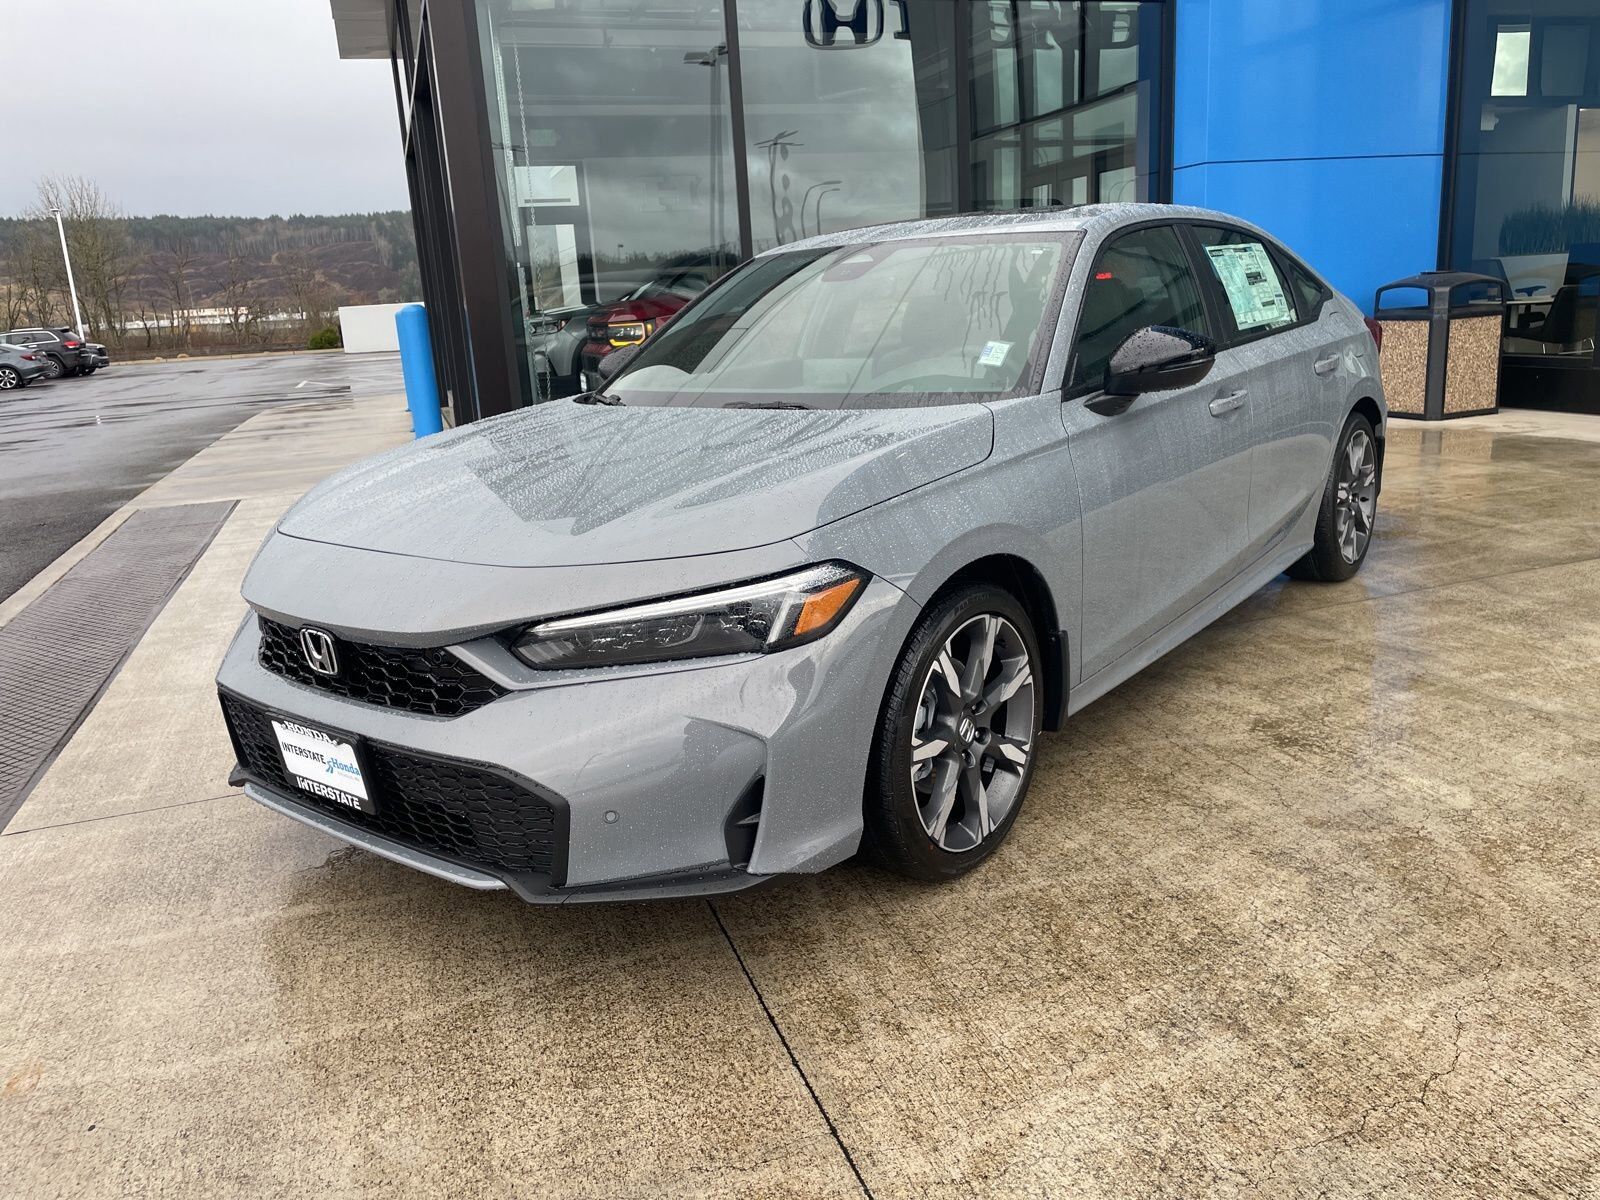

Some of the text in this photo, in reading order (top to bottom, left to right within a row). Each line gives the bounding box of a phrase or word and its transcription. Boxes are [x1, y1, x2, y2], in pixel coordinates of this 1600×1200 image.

[284, 720, 332, 743] HONDA
[281, 741, 361, 776] INTERSTATE Honda
[296, 775, 362, 811] INTERSTATE
